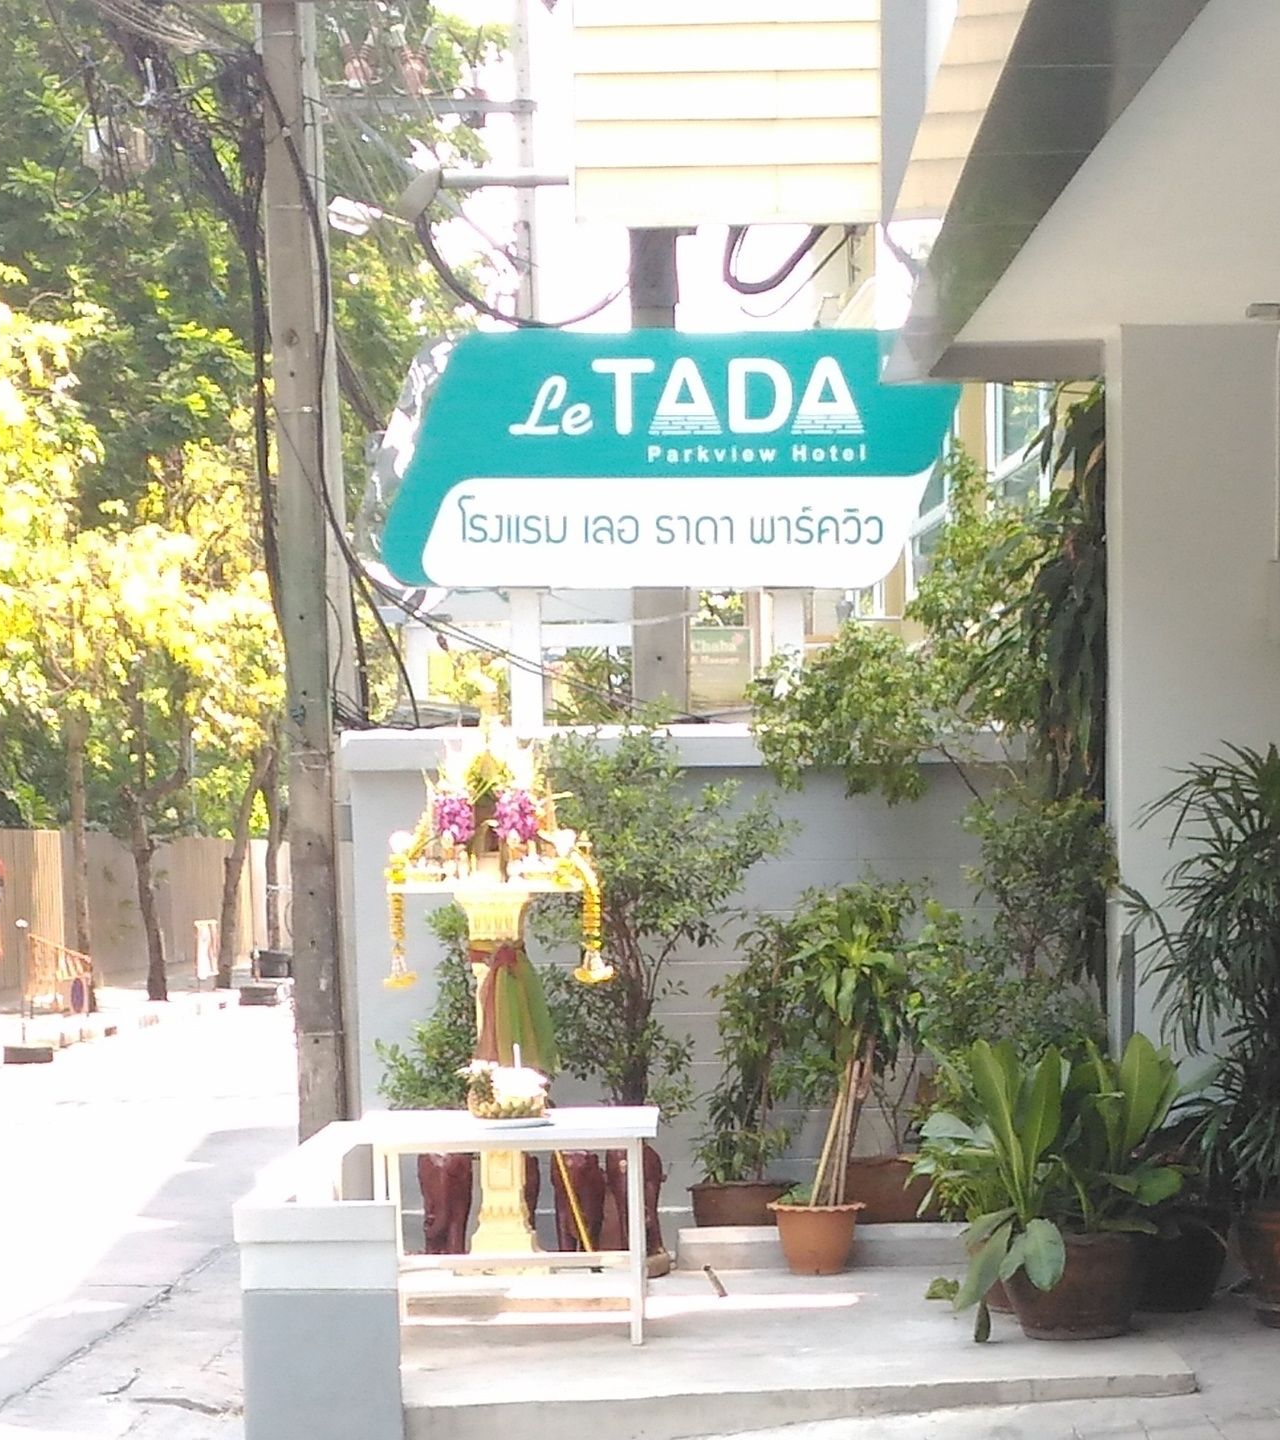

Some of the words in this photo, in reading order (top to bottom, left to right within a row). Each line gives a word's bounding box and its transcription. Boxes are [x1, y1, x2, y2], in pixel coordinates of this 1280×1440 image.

[508, 374, 593, 436] Le
[591, 356, 866, 436] TADA
[647, 445, 777, 463] Parkview
[792, 444, 867, 463] Hotel
[457, 494, 568, 545] โรงแรม
[584, 514, 640, 545] เลอ
[655, 514, 735, 546] ราดา
[749, 505, 884, 546] พาร์ควิว
